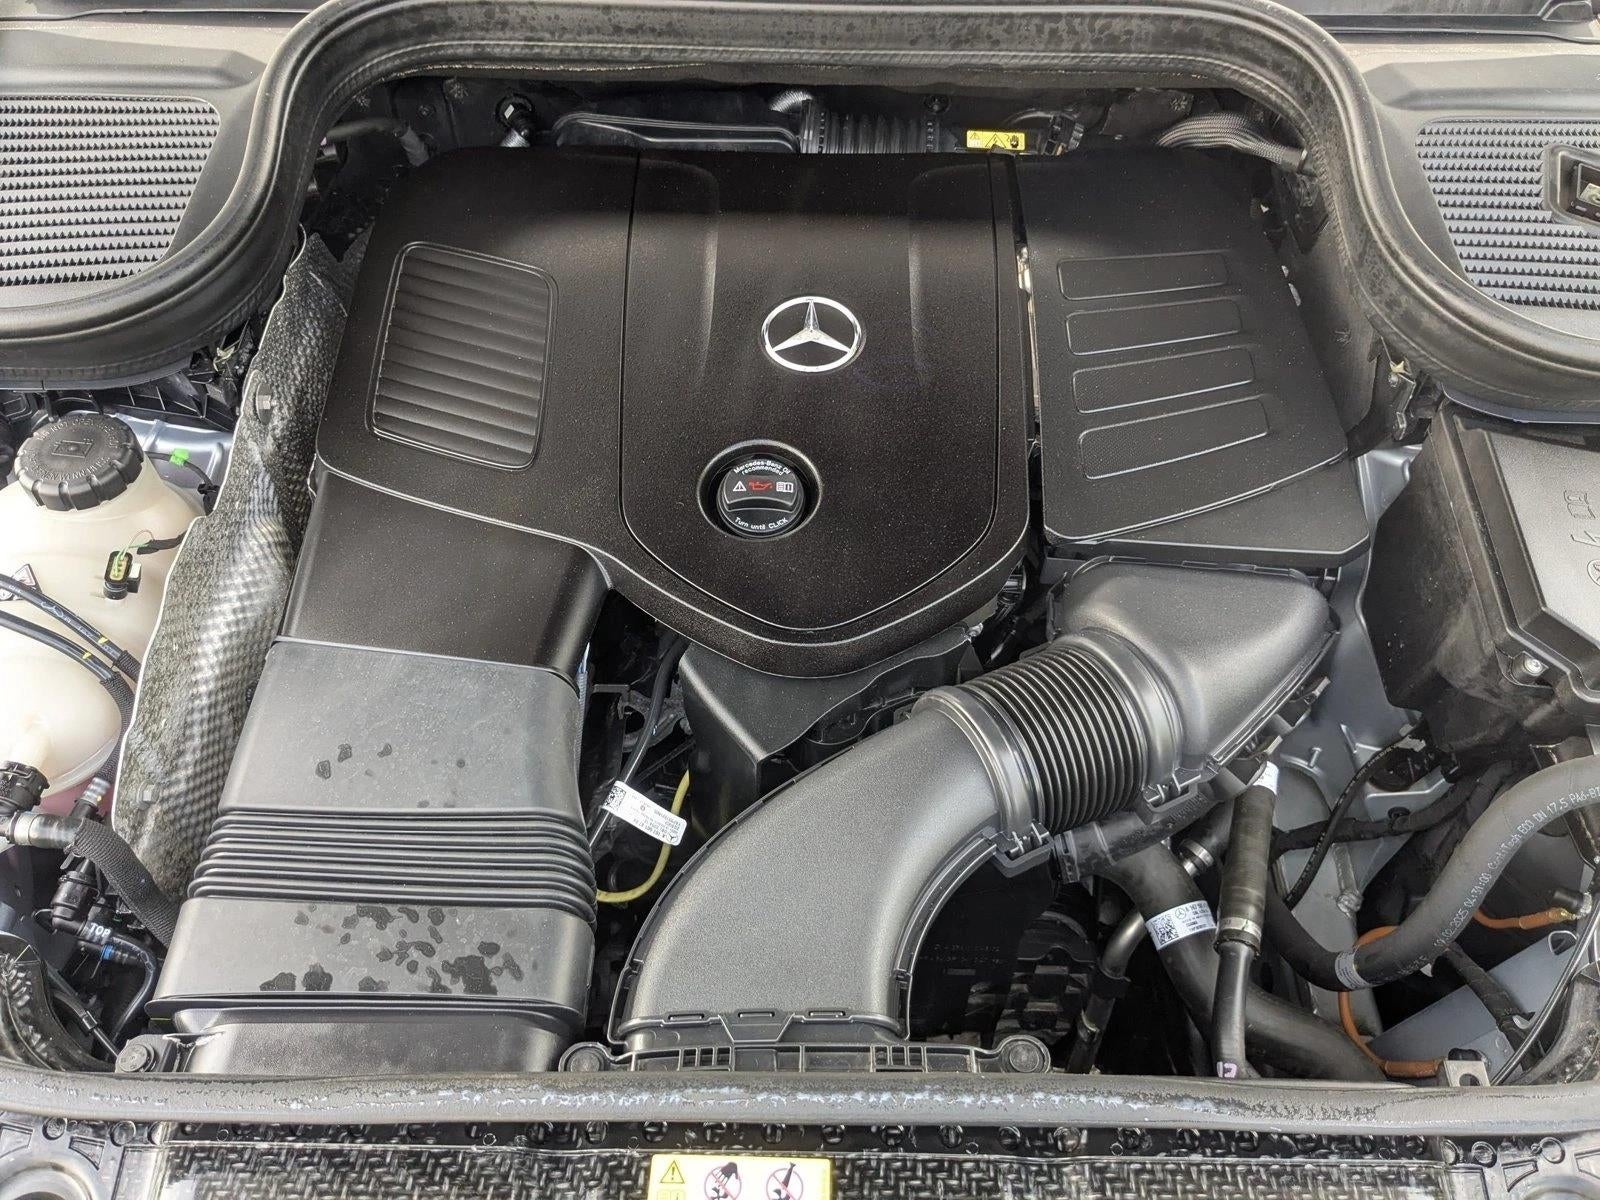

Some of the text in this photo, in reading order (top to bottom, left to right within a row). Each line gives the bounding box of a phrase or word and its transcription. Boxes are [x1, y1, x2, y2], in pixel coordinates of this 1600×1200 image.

[733, 460, 783, 474] Mercedes-Benz
[741, 465, 784, 476] recommended
[734, 517, 749, 528] Turn
[768, 517, 788, 529] CLICK
[90, 922, 112, 938] TOP
